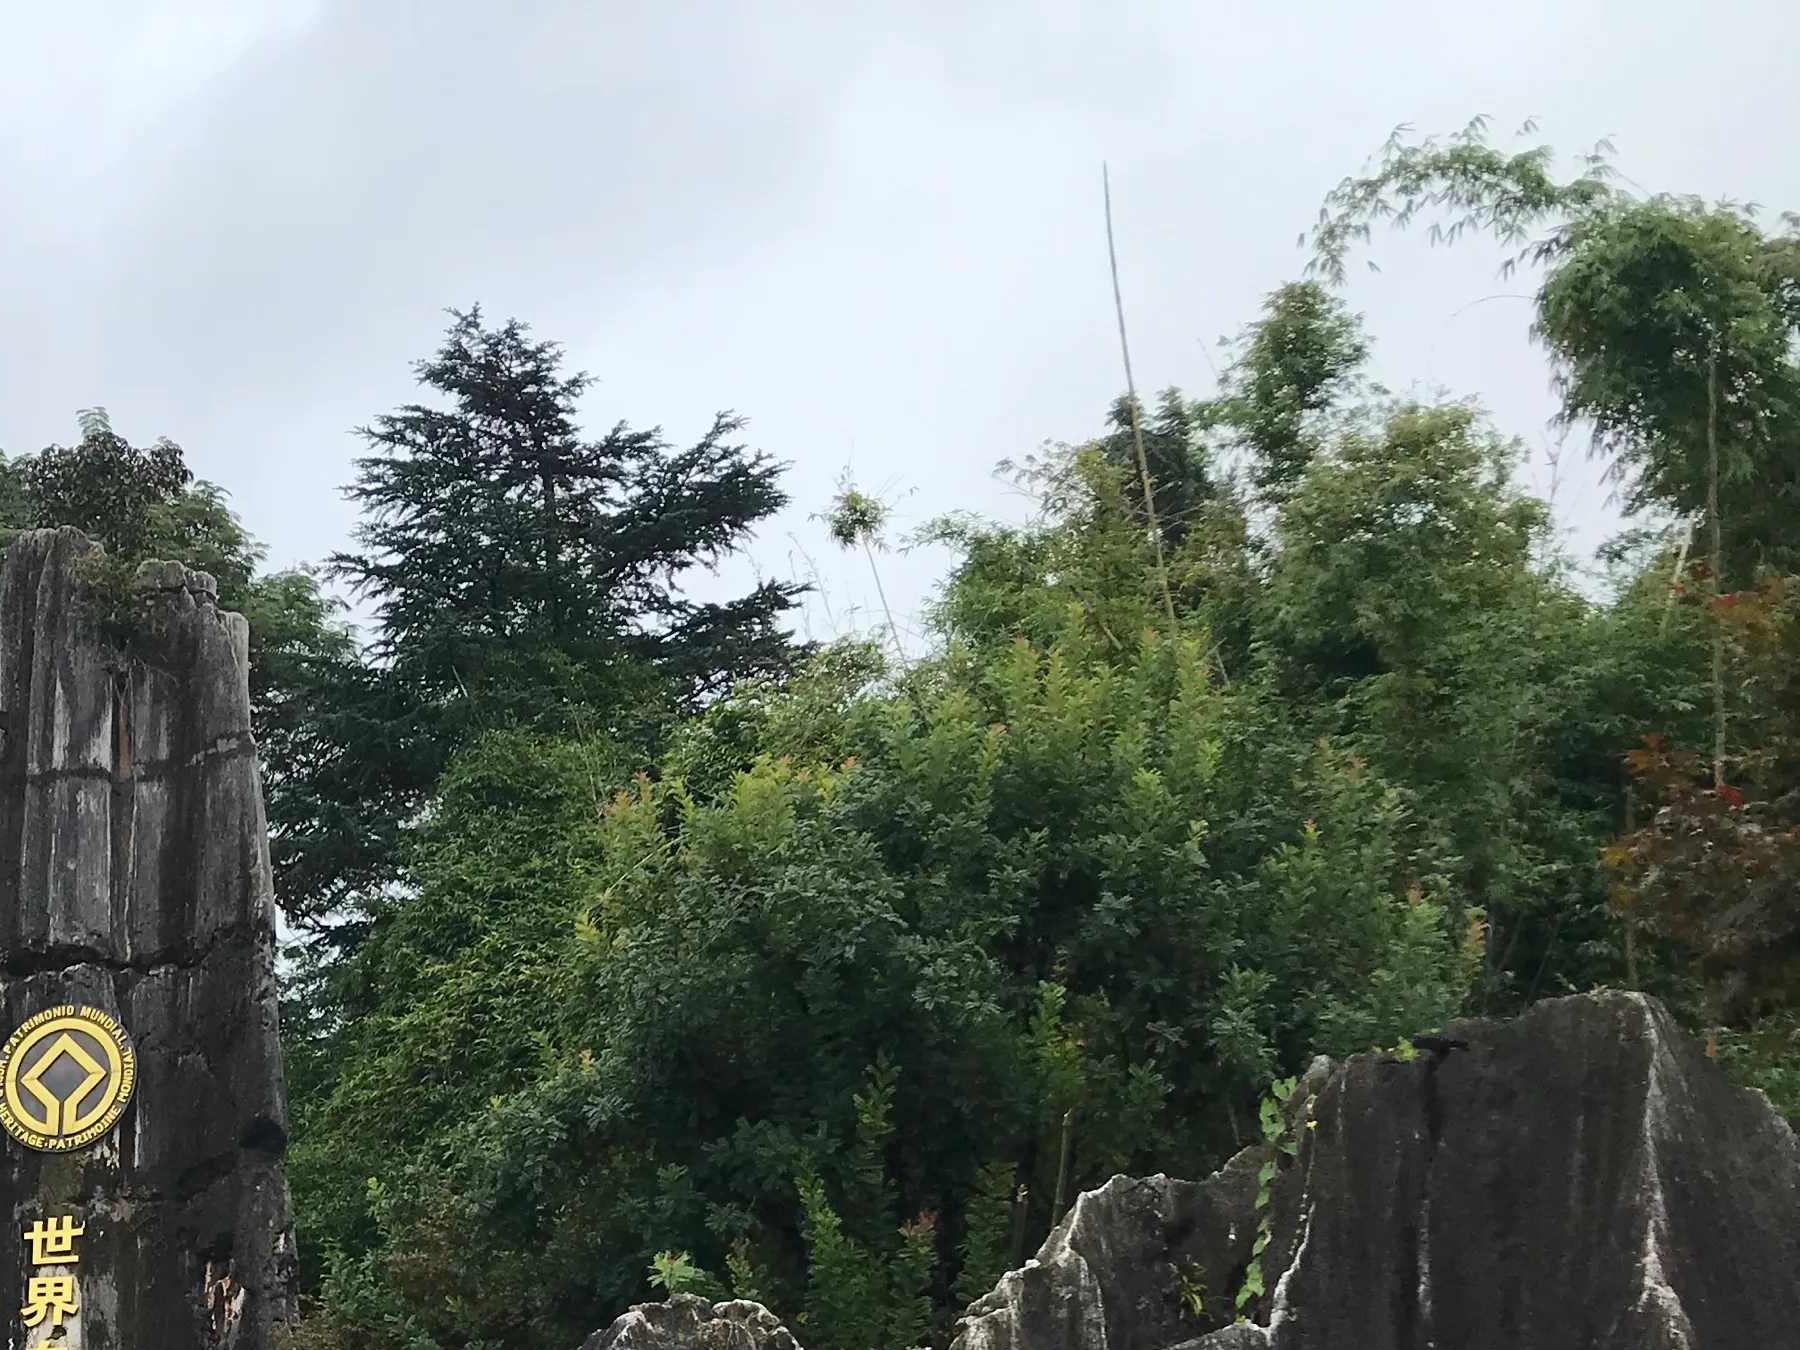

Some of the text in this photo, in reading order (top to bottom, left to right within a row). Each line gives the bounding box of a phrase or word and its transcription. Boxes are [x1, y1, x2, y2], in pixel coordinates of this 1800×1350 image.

[2, 1004, 128, 1054] PATRIMONIO MUNDIAL
[48, 1046, 135, 1149] PATRIMOINE MONDIAL
